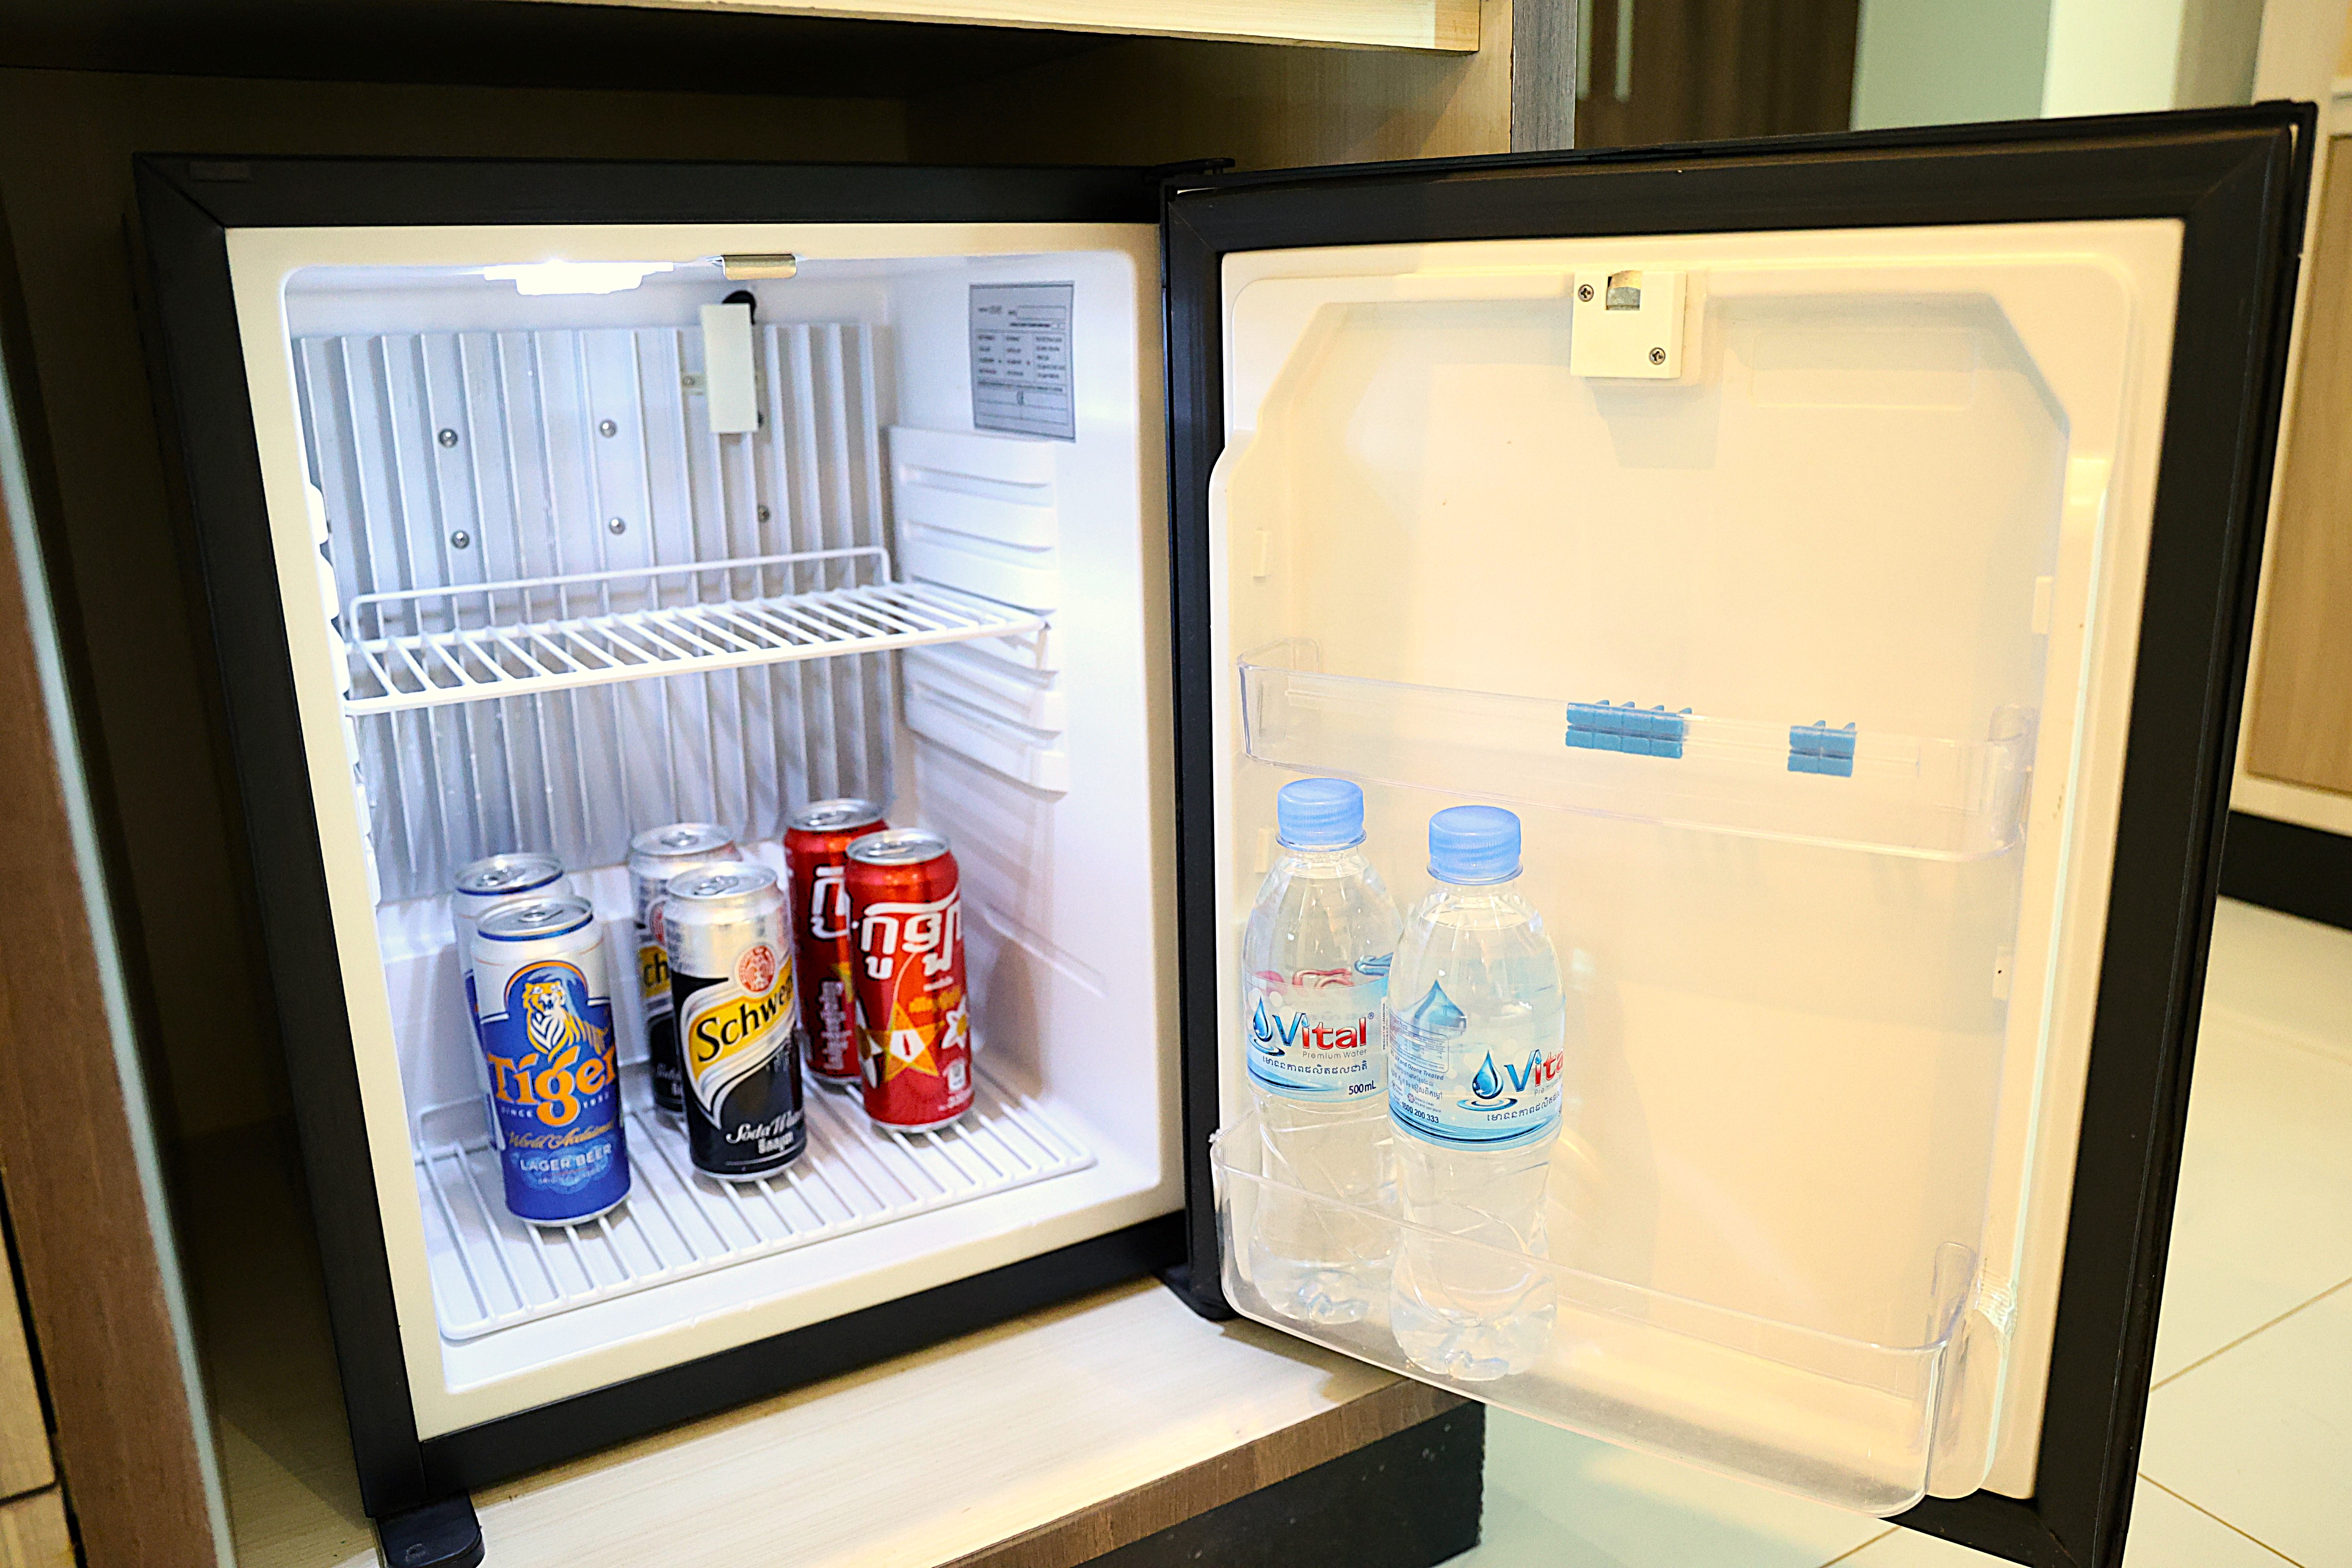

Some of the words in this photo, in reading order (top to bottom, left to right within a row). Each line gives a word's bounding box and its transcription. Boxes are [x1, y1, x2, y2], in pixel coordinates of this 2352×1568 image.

[1303, 1051, 1341, 1059] Premium
[1343, 1048, 1367, 1058] Water
[1408, 1064, 1422, 1074] Ozone
[1423, 1070, 1444, 1080] Treated
[488, 1045, 617, 1127] Tiger
[1348, 1080, 1377, 1095] 500mL
[1401, 1102, 1413, 1113] 1800
[1414, 1109, 1425, 1119] 200
[1426, 1114, 1439, 1124] 333
[725, 1123, 771, 1144] Soda
[520, 1156, 571, 1173] LAGER
[575, 1143, 613, 1167] BEER
